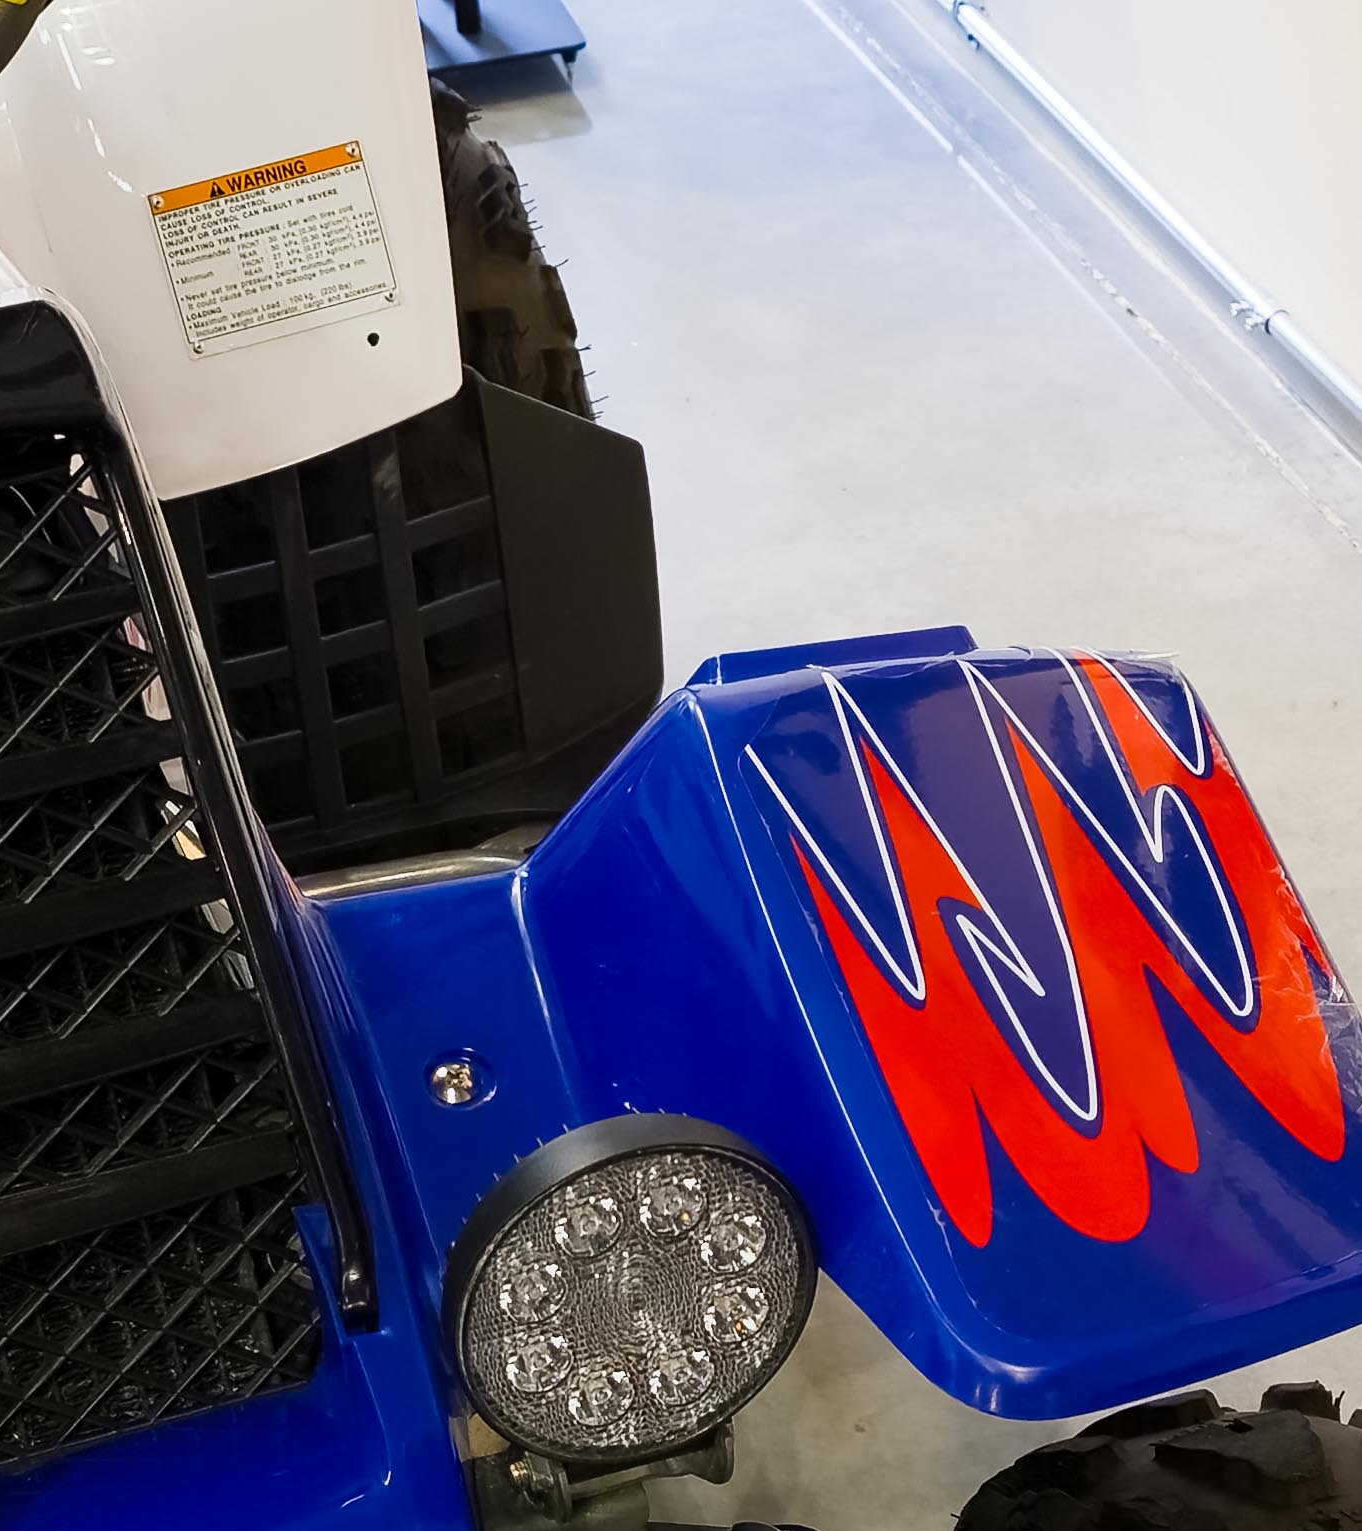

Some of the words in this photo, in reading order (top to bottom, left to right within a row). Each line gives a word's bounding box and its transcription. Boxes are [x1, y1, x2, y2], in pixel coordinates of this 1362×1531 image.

[226, 159, 307, 193] WARNING
[158, 206, 200, 223] IMPROPER
[203, 201, 221, 211] TIRE
[224, 189, 265, 205] PRESSURE
[269, 185, 282, 193] OR
[284, 169, 341, 189] OVERLOADING
[343, 164, 361, 174] CAN
[160, 218, 188, 231] CAUSE
[191, 212, 212, 223] LOSS
[214, 208, 226, 217] OF
[163, 228, 185, 240] LOSS
[187, 225, 198, 234] OF
[201, 214, 239, 230] CONTROL
[242, 209, 260, 219] CAN
[262, 200, 293, 214] RESULT
[295, 197, 304, 205] IN
[308, 188, 338, 202] SEVERE
[165, 235, 194, 248] INJURY
[197, 231, 209, 240] OR
[168, 241, 215, 259] OPERATING
[218, 235, 236, 246] TIRE
[186, 291, 207, 302] Never
[241, 274, 273, 289] pressure
[276, 267, 297, 278] below
[196, 297, 217, 309] could
[220, 291, 242, 303] cause
[245, 287, 257, 296] the
[259, 283, 272, 292] tire
[275, 280, 283, 288] to
[319, 266, 336, 276] from
[339, 262, 351, 271] the
[186, 307, 222, 322] LOADING
[193, 314, 228, 329] Maximum
[231, 306, 259, 319] Vehicle
[196, 324, 227, 338] Includes
[257, 314, 265, 322] of
[327, 294, 341, 303] and
